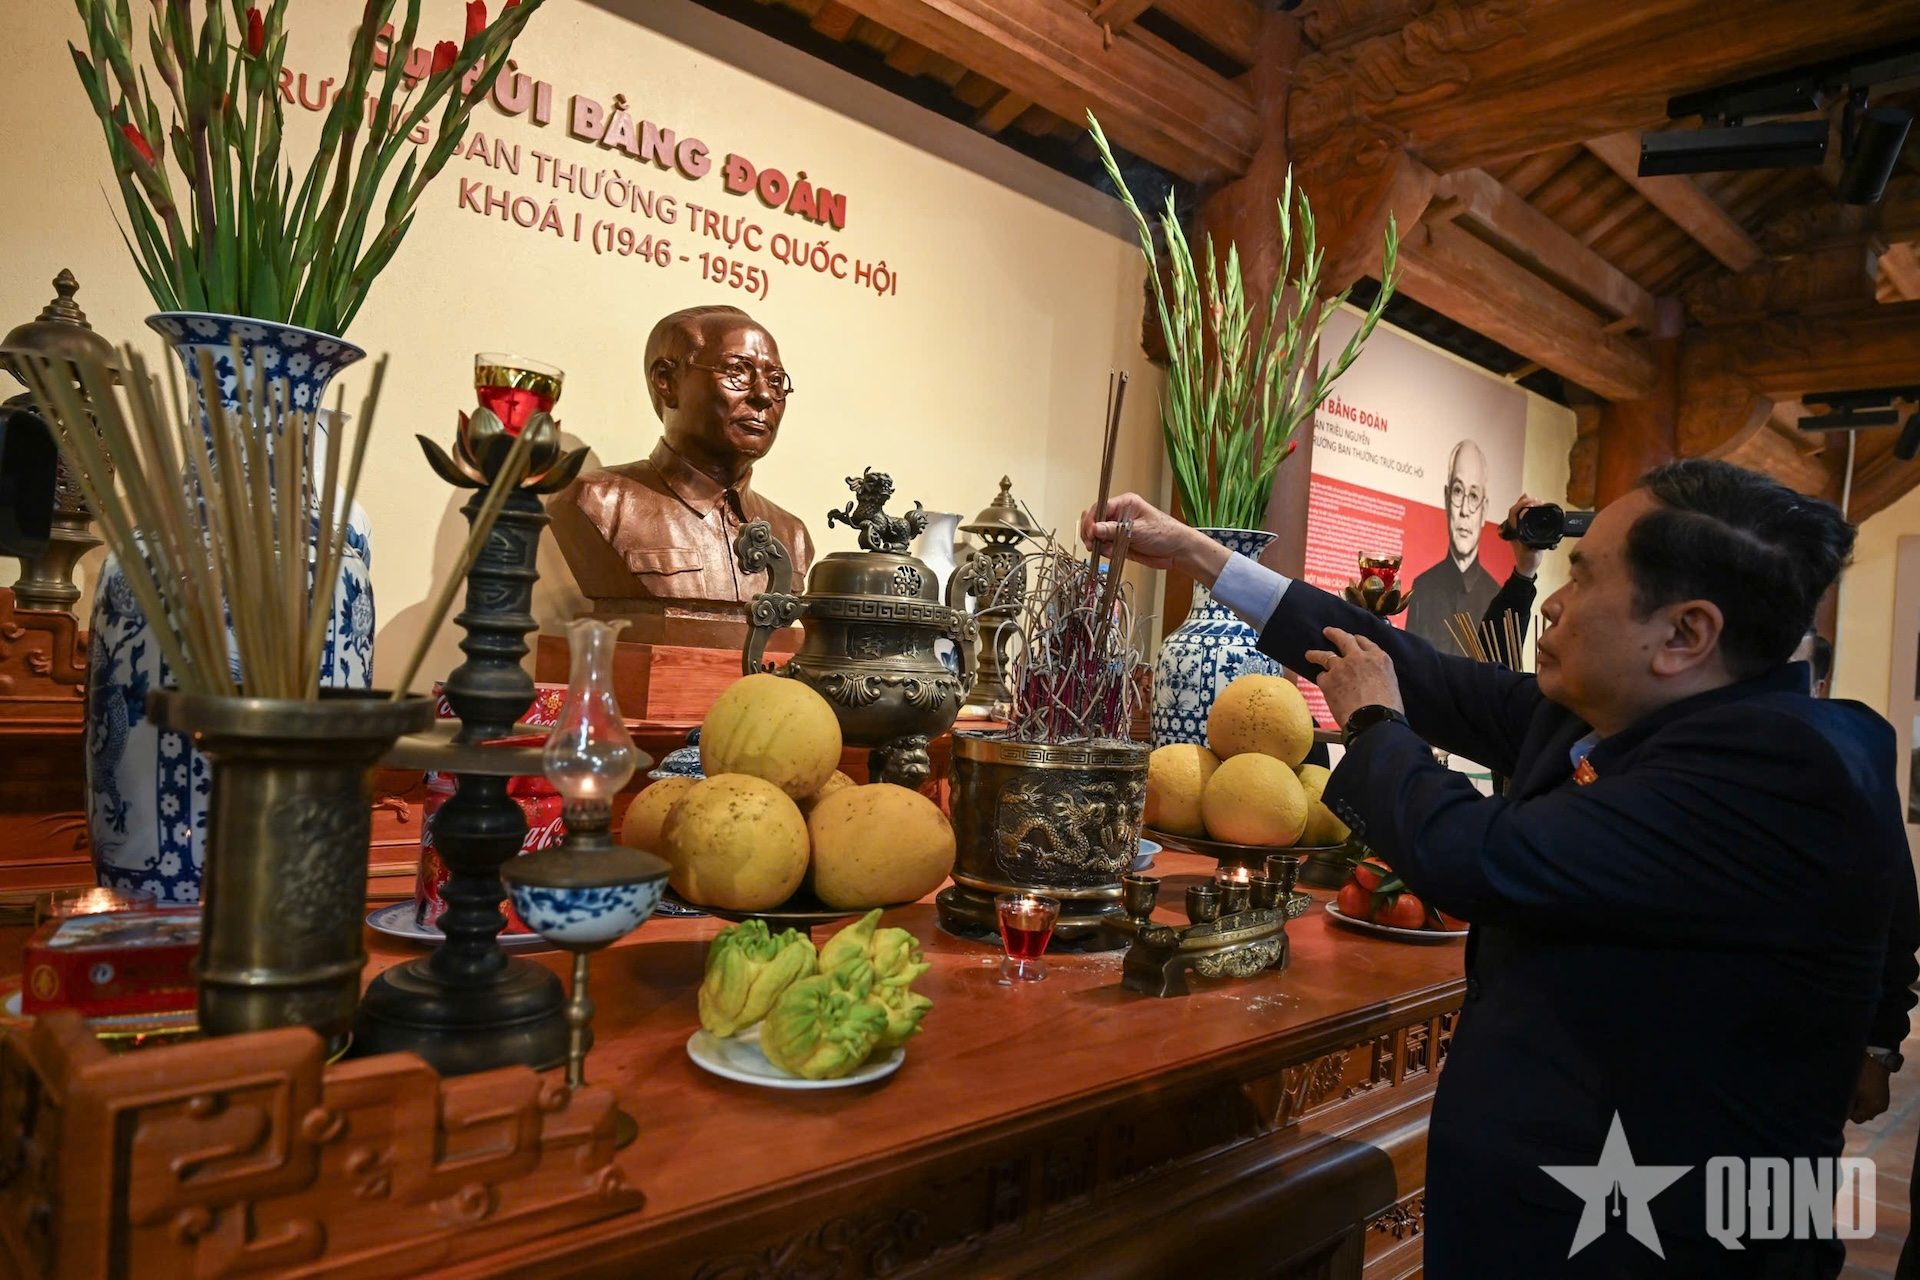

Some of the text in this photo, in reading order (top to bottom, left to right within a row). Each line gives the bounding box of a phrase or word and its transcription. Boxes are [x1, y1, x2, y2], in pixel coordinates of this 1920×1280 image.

[277, 66, 897, 296] RƯNG AN THƯỜNG TRỰC QUỐC HỘI
[570, 93, 712, 180] BẰNG
[723, 153, 847, 232] ĐOÀN
[459, 177, 564, 237] KHOÁ
[573, 212, 582, 242] I
[592, 219, 672, 268] (1946
[699, 251, 769, 301] 1955)
